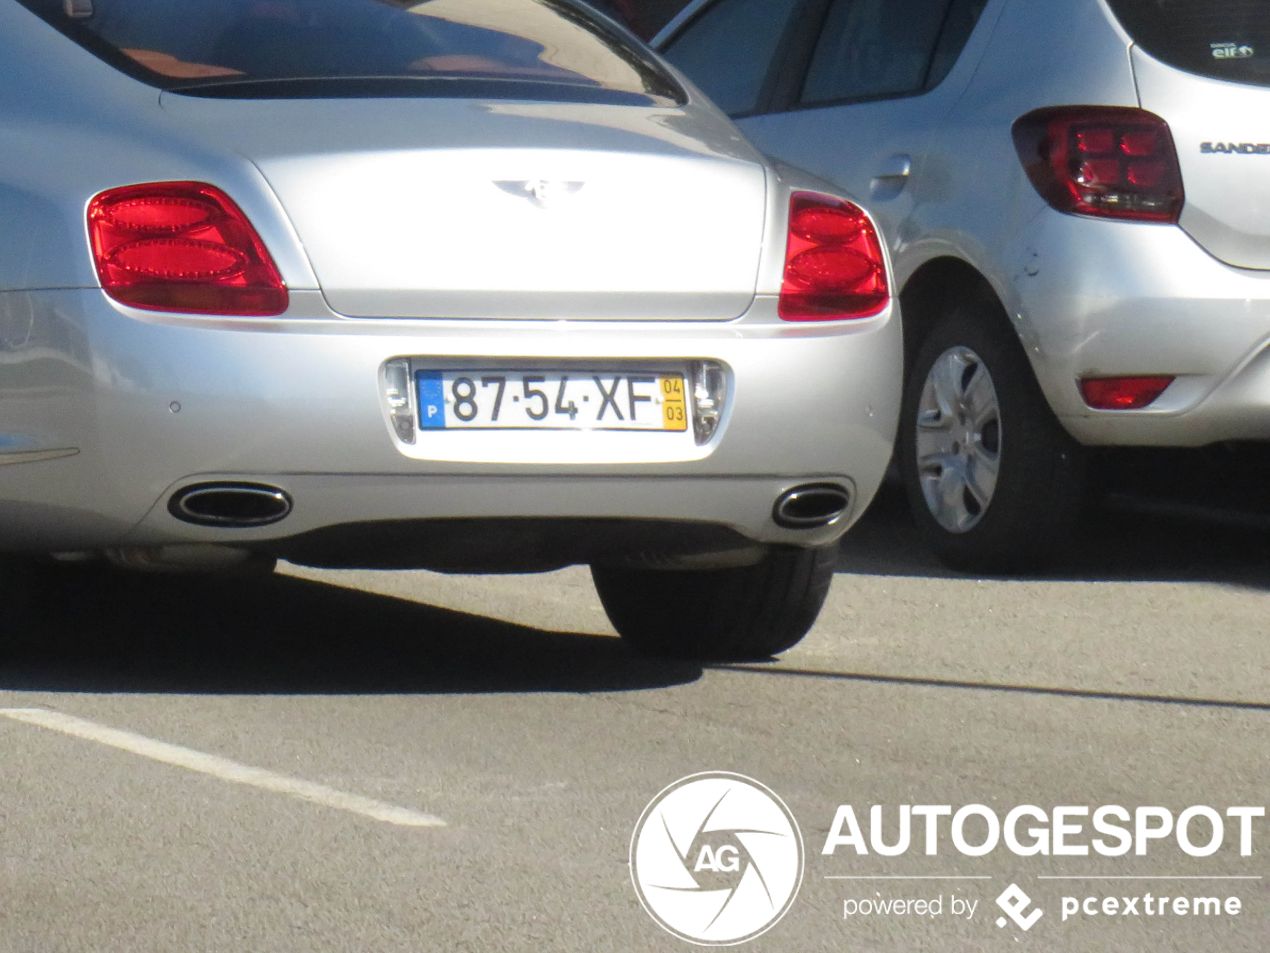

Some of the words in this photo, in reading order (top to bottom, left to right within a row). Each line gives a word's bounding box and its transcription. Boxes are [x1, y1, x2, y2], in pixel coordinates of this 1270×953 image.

[1212, 48, 1236, 58] elf
[663, 379, 681, 394] 04
[427, 405, 438, 418] P
[666, 406, 684, 421] 03
